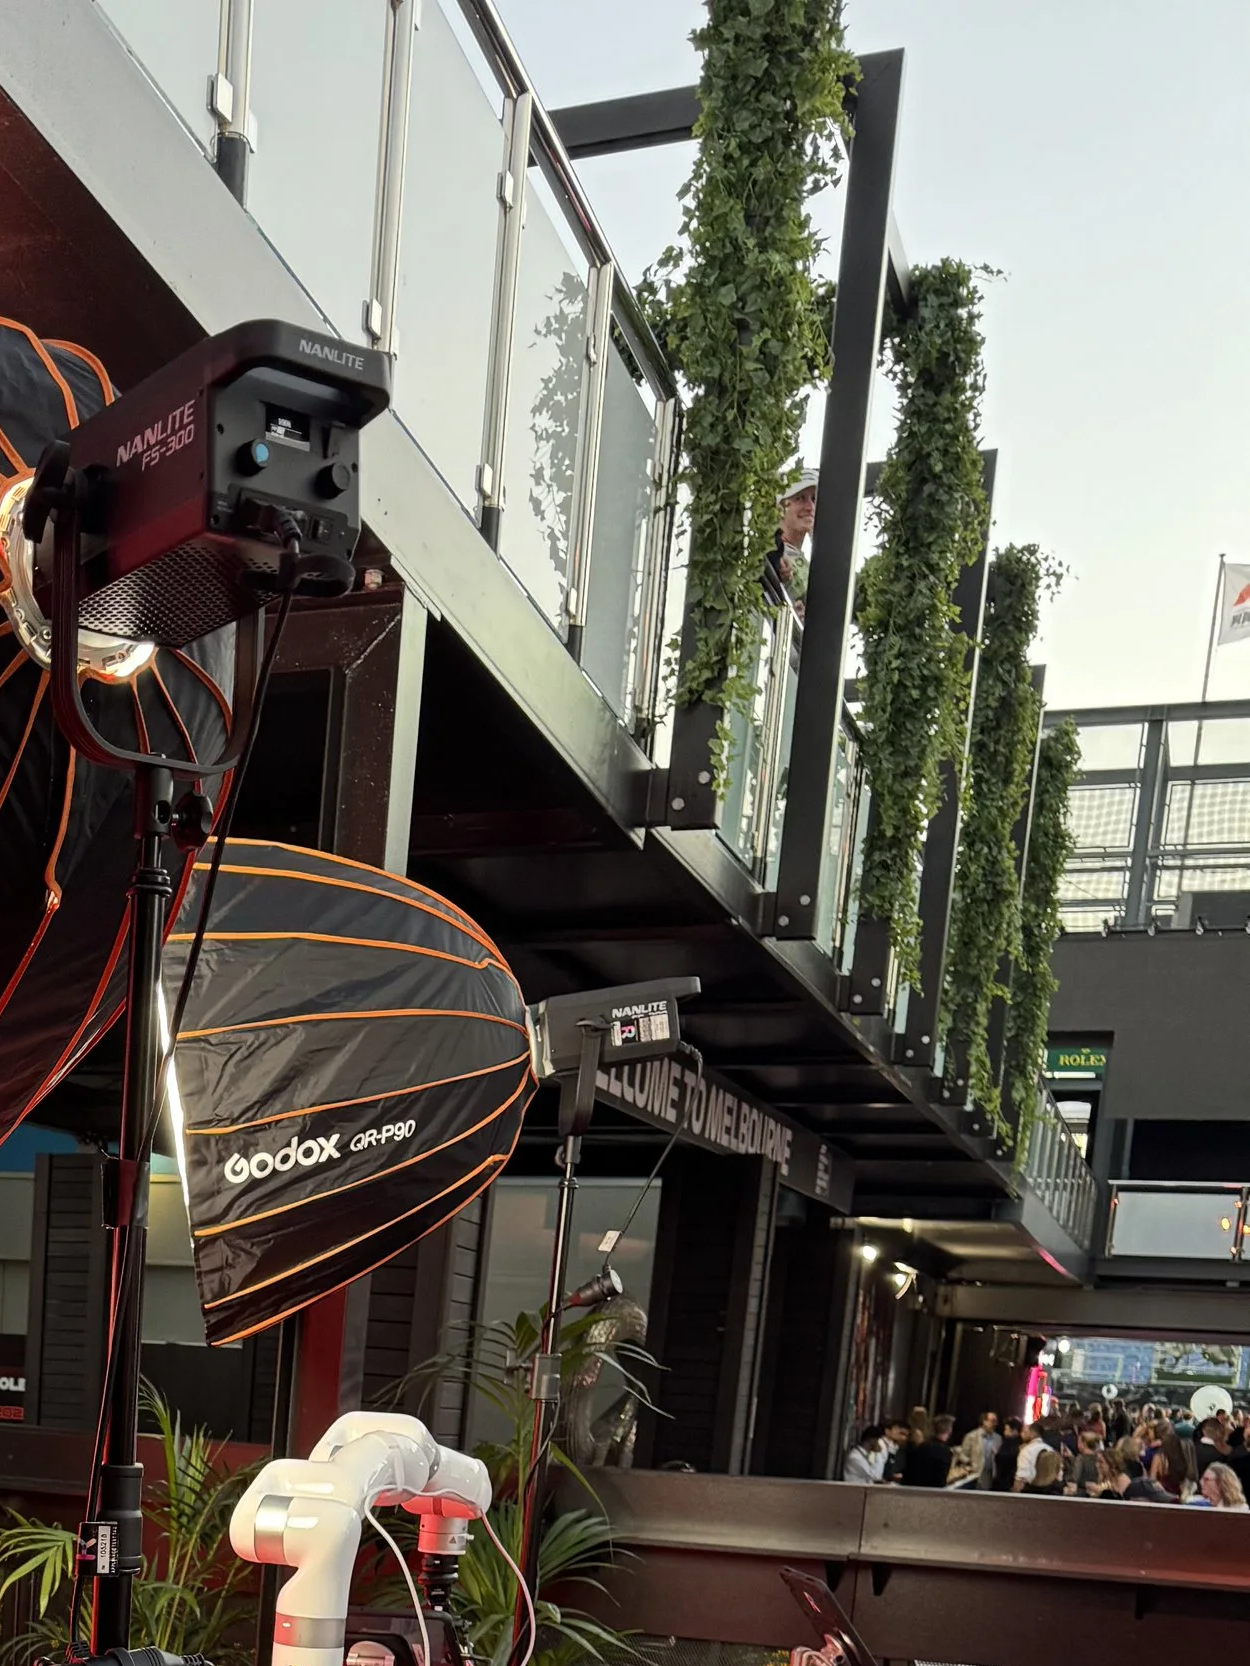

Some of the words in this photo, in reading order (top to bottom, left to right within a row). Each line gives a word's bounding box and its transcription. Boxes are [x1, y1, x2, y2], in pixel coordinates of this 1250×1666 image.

[299, 339, 365, 370] NANLITE
[116, 400, 196, 468] NANLITE
[141, 424, 195, 472] FS-300
[612, 1001, 667, 1018] NANLITE
[224, 1133, 342, 1184] Godox
[349, 1119, 417, 1152] QR-P90
[705, 1085, 793, 1177] MELBOURNE
